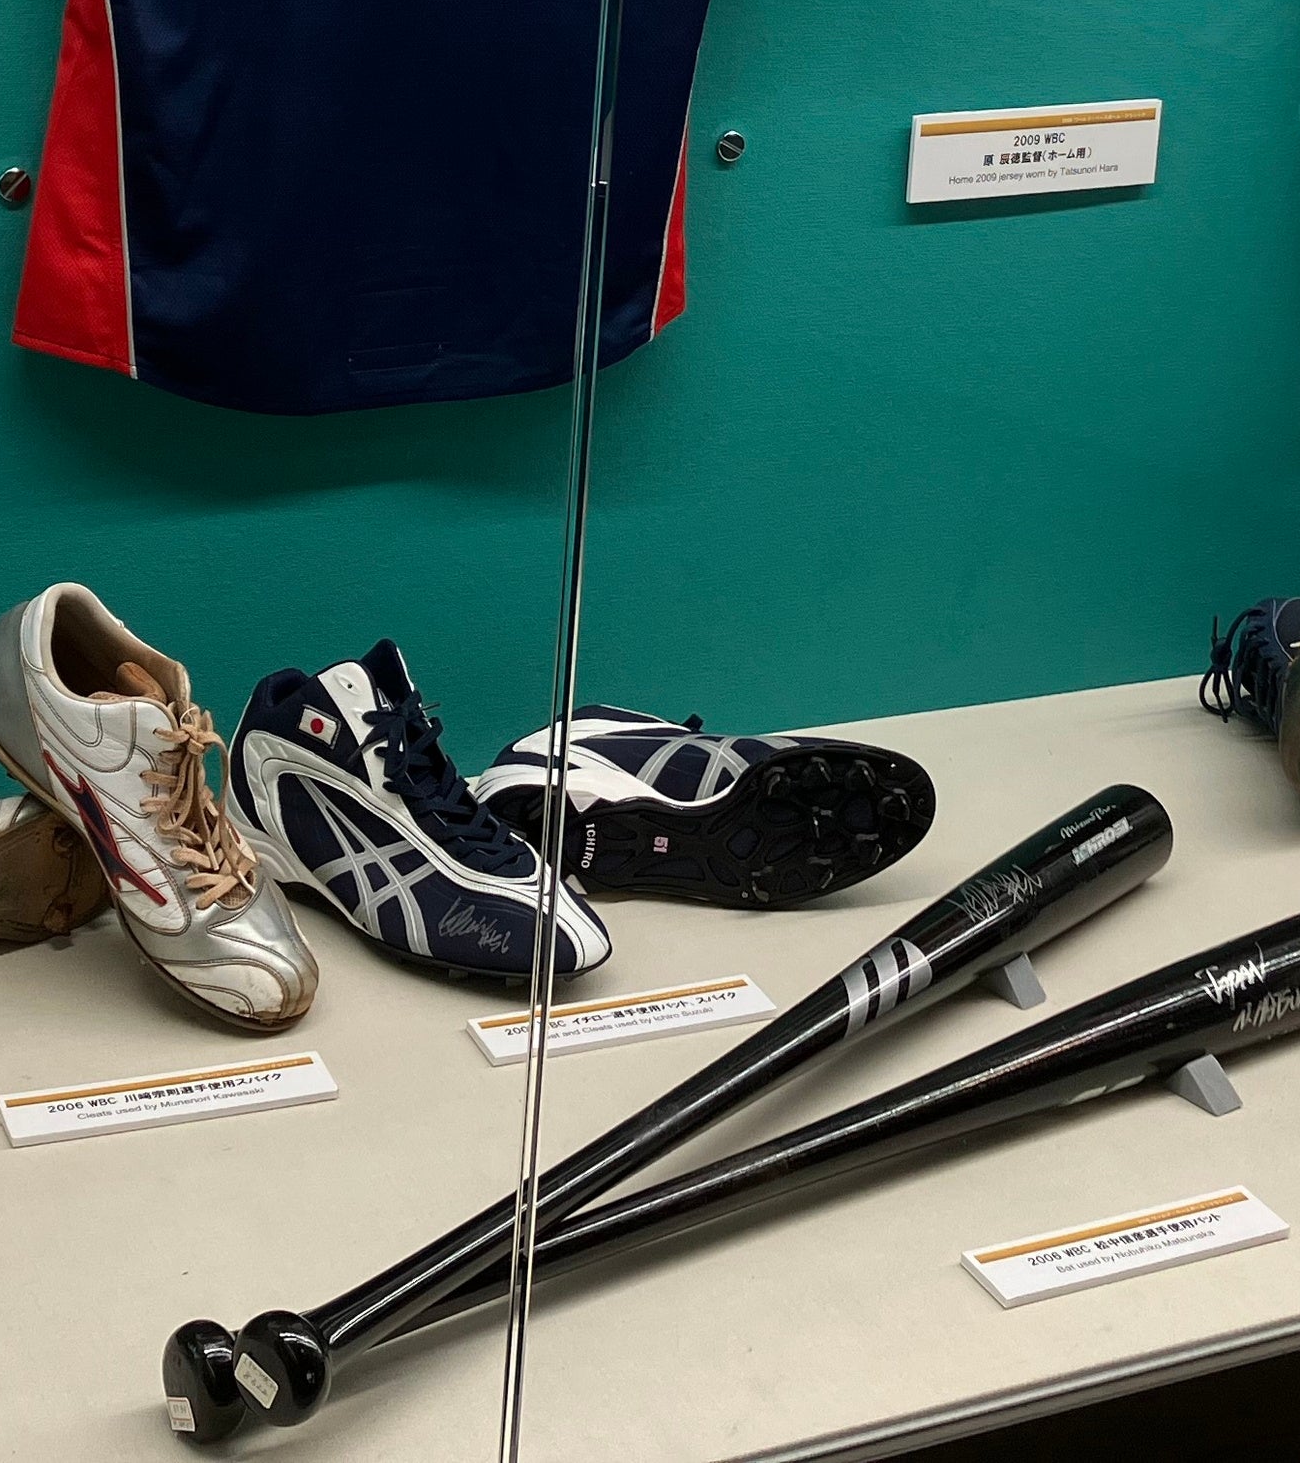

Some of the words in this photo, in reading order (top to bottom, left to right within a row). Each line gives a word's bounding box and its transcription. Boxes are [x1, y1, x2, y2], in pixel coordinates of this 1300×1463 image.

[1013, 135, 1040, 147] 2009
[1044, 132, 1066, 144] WBC
[983, 154, 994, 167] 原
[999, 146, 1092, 165] 辰徳監督（ホーム用）
[949, 175, 973, 185] Home
[975, 172, 997, 183] 2009
[997, 171, 1023, 184] jersey
[1025, 169, 1046, 179] worn
[1047, 169, 1058, 180] by
[1059, 165, 1096, 176] Tatsunori
[1099, 163, 1118, 173] Hara
[581, 823, 596, 869] ICHIRO
[653, 836, 669, 853] 51
[504, 1025, 532, 1036] 200
[562, 1027, 581, 1038] and
[582, 1023, 613, 1035] Cleats
[614, 1019, 638, 1031] used
[640, 1017, 652, 1027] by
[653, 1012, 680, 1023] Ichiro
[681, 1007, 714, 1019] Suzuki
[47, 1100, 84, 1114] 2006
[88, 1096, 117, 1109] WBC
[77, 1109, 112, 1120] Cleats
[115, 1105, 142, 1116] used
[144, 1102, 158, 1113] by
[160, 1095, 211, 1109] Munenori
[213, 1087, 264, 1100] Kawasaki
[1028, 1252, 1063, 1267] 2006
[1062, 1244, 1092, 1258] WBC
[1095, 1212, 1221, 1250] 松中信彦選手使用バット
[1056, 1263, 1076, 1274] Bat
[1077, 1257, 1100, 1270] used
[1102, 1252, 1115, 1266] by
[1116, 1242, 1162, 1260] Nobuhiko
[1164, 1230, 1216, 1249] Matsunaka
